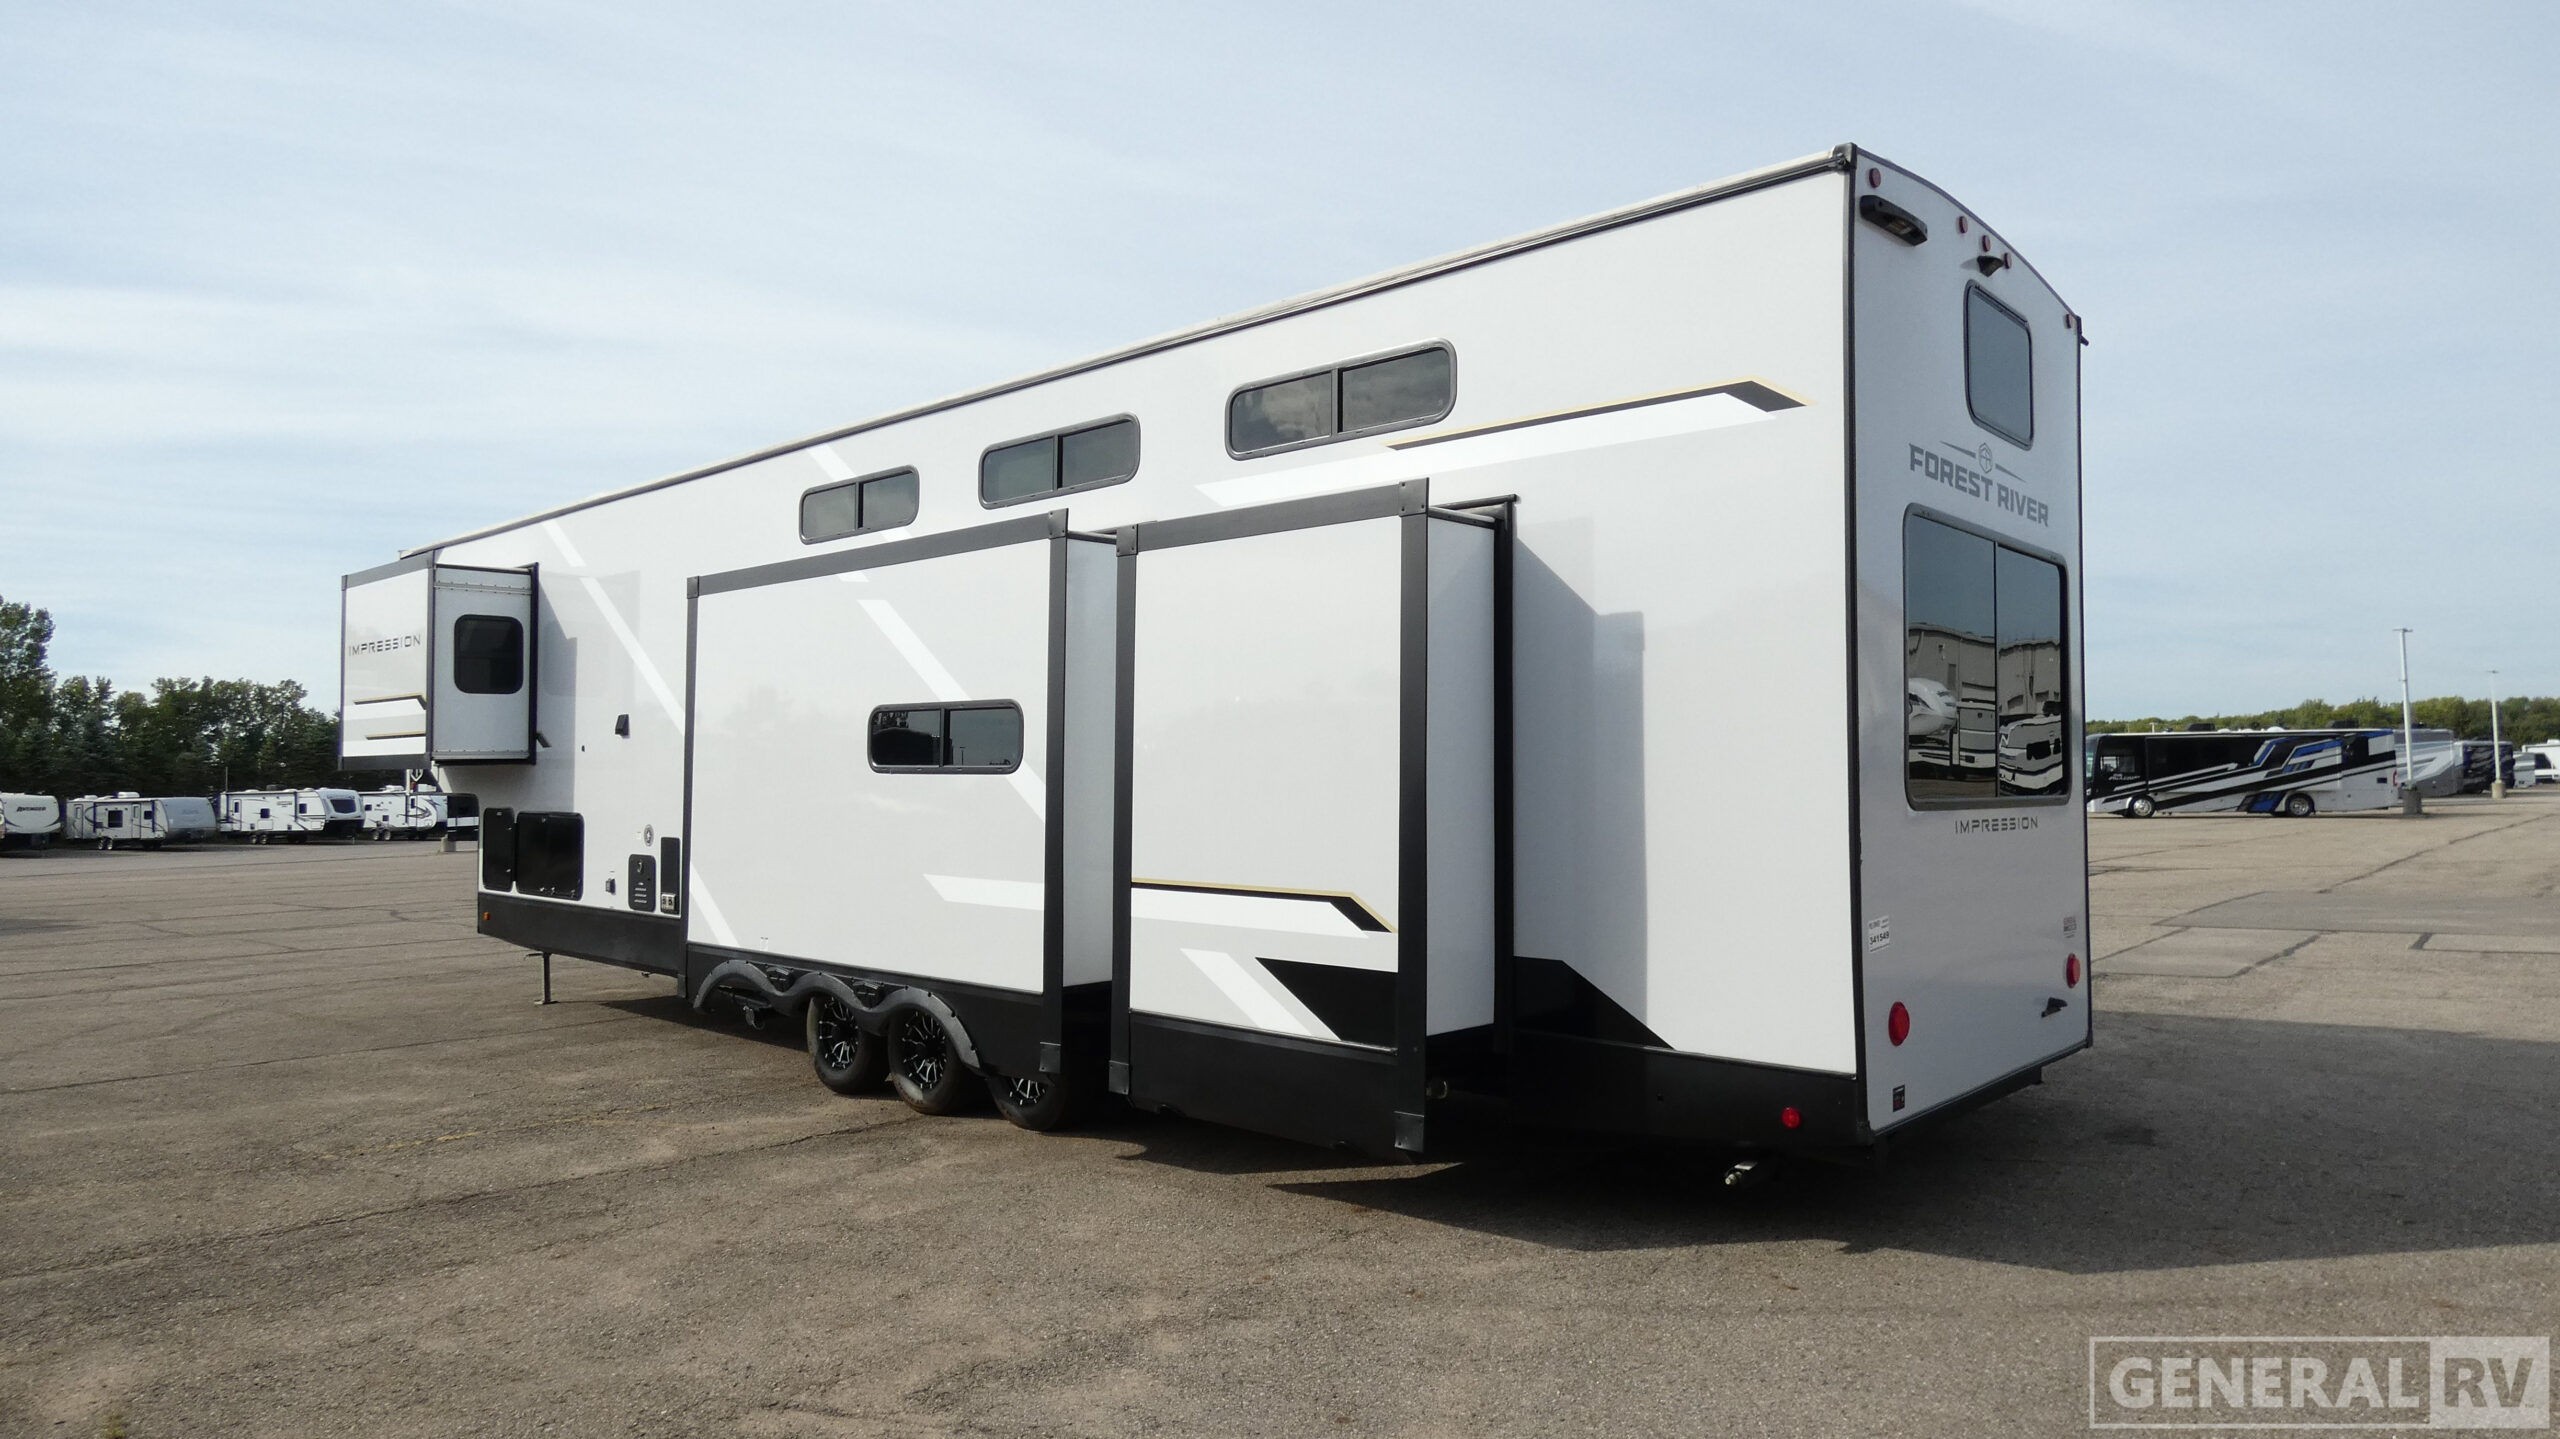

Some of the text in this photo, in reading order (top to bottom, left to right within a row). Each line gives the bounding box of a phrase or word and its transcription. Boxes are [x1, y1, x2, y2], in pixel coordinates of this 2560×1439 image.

[1908, 443, 2049, 527] FOREST RIVER
[348, 634, 422, 657] IMPRESSION
[1954, 816, 2039, 834] IMPRESSION
